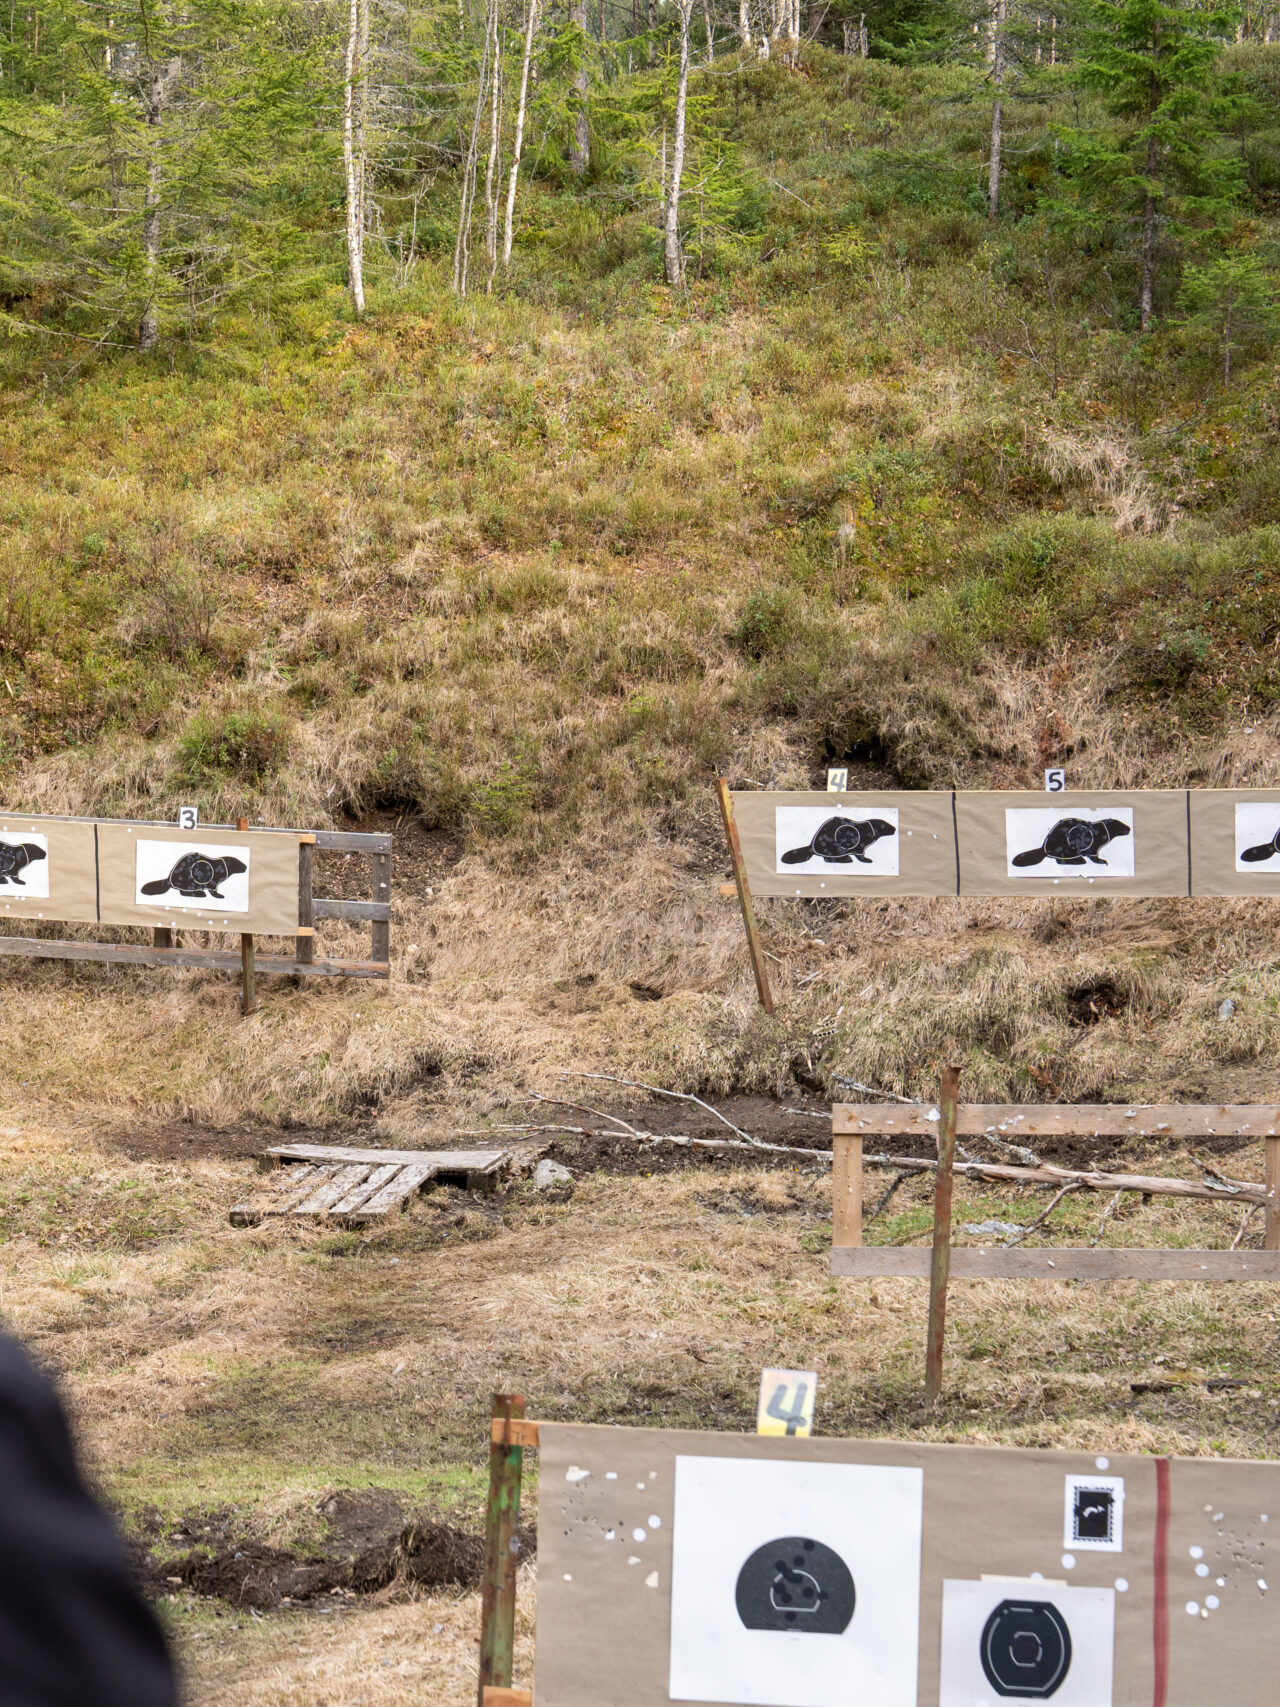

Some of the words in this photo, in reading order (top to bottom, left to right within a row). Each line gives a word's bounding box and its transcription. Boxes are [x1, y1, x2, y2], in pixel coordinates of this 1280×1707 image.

[830, 772, 845, 792] 4
[1048, 771, 1063, 792] 5
[182, 809, 196, 829] 3
[766, 1382, 808, 1436] 4
